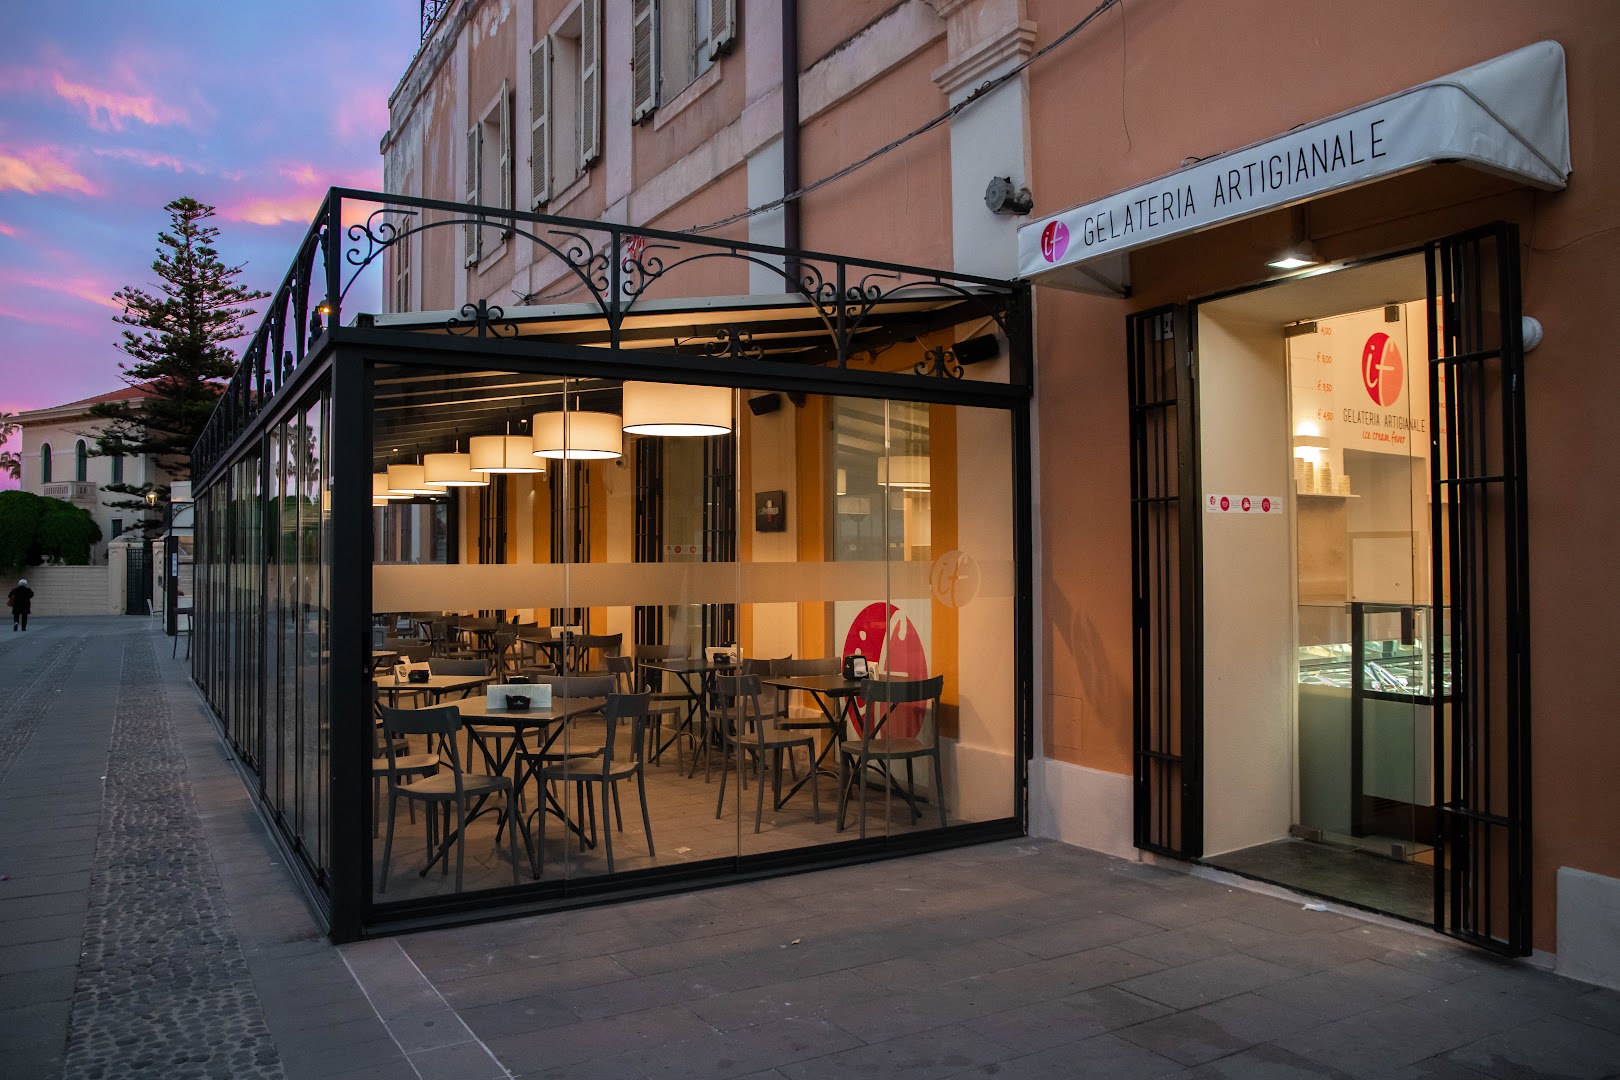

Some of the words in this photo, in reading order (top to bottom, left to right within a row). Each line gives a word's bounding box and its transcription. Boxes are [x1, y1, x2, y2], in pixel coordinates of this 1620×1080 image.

[1083, 184, 1196, 247] GELATERIA
[1213, 119, 1387, 208] ARTIGIANALE
[1342, 408, 1380, 427] GELATERIA
[1384, 414, 1426, 433] ARTIGIANALE
[1362, 430, 1372, 440] ice
[1372, 431, 1390, 442] cream
[1391, 430, 1406, 446] fever
